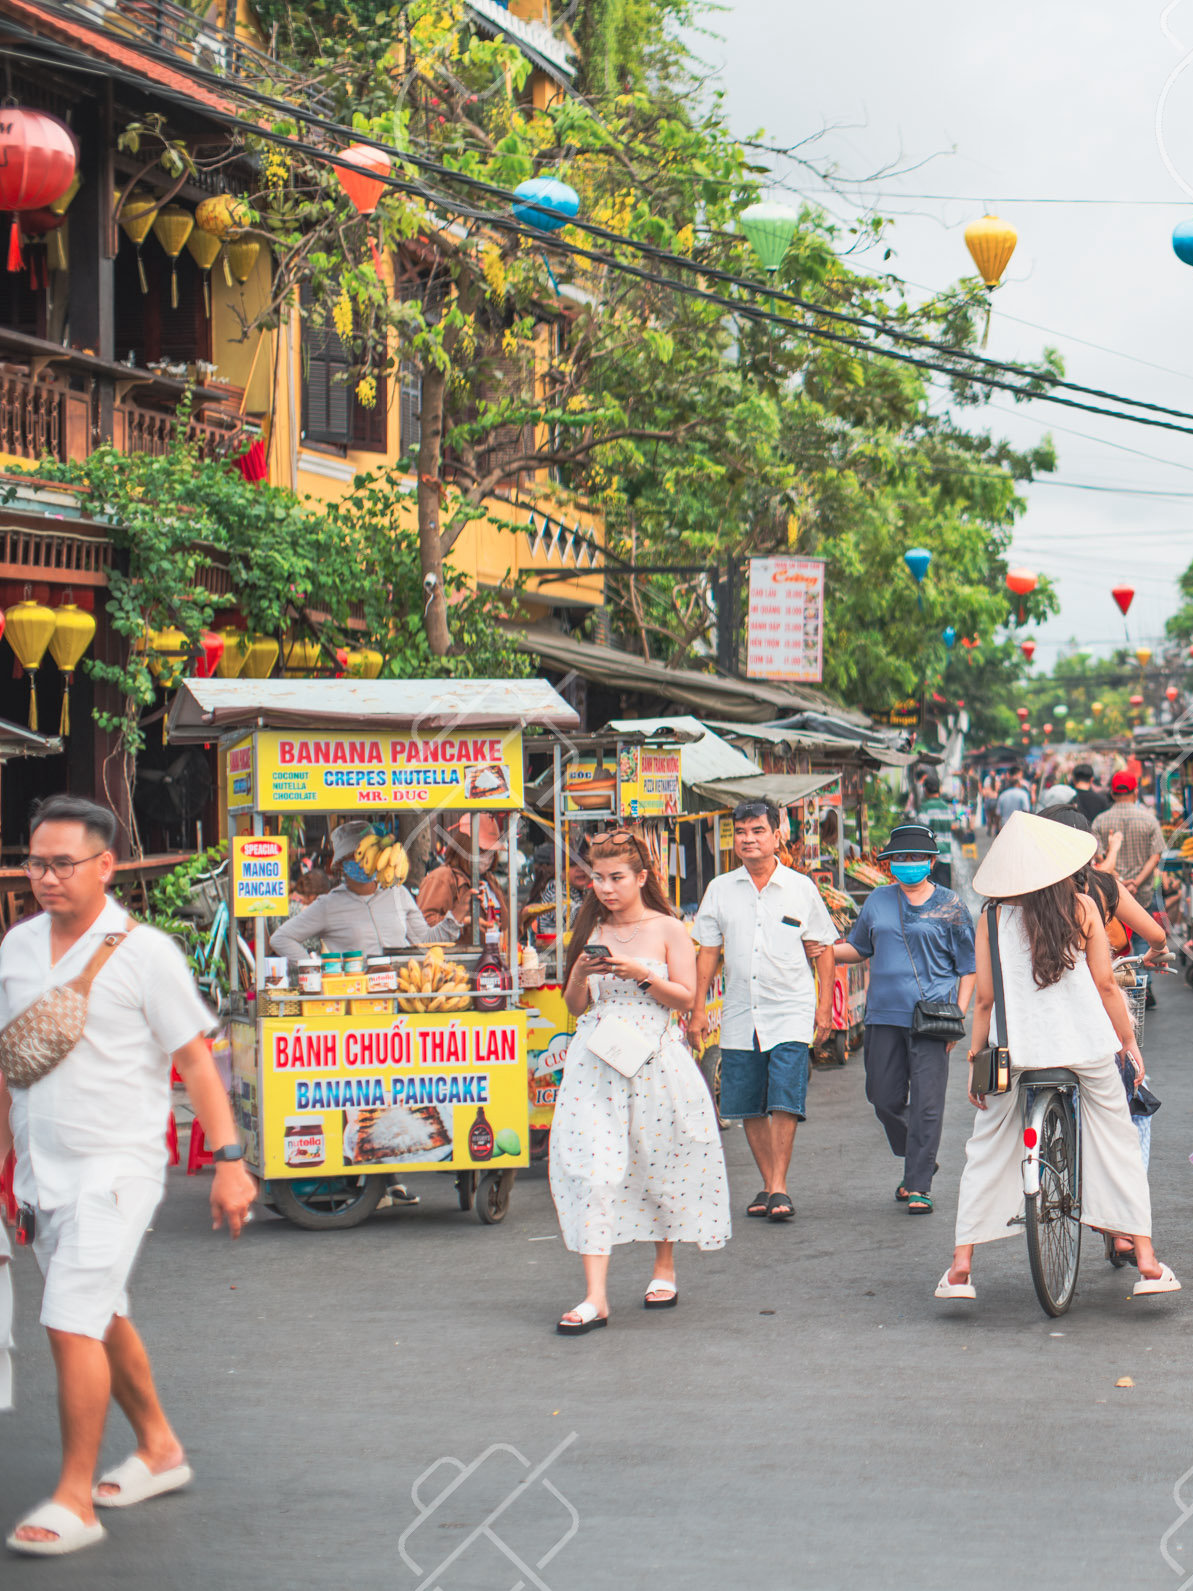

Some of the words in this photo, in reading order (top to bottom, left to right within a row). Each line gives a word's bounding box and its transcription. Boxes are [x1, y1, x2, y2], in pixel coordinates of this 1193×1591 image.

[279, 740, 383, 765] BANANA
[391, 739, 503, 763] PANCAKE
[272, 772, 309, 780] COCONUT
[323, 770, 387, 787] CREPES
[391, 769, 460, 785] NUTELLA
[272, 782, 307, 790] NUTELLA
[272, 792, 317, 800] CHOCOLATE
[358, 790, 387, 803] MR.
[392, 790, 429, 801] DUC
[244, 843, 279, 855] SPEACIAL
[242, 862, 280, 878] MANGO
[238, 881, 285, 897] PANCAKE
[367, 974, 396, 985] nutella
[275, 1026, 338, 1069] BÁNH
[345, 1019, 412, 1065] CHUỐI
[419, 1020, 467, 1063] THÁI
[475, 1029, 517, 1061] LAN
[297, 1078, 386, 1110] BANANA
[392, 1075, 488, 1106] PANCAKE
[288, 1137, 322, 1148] nutella
